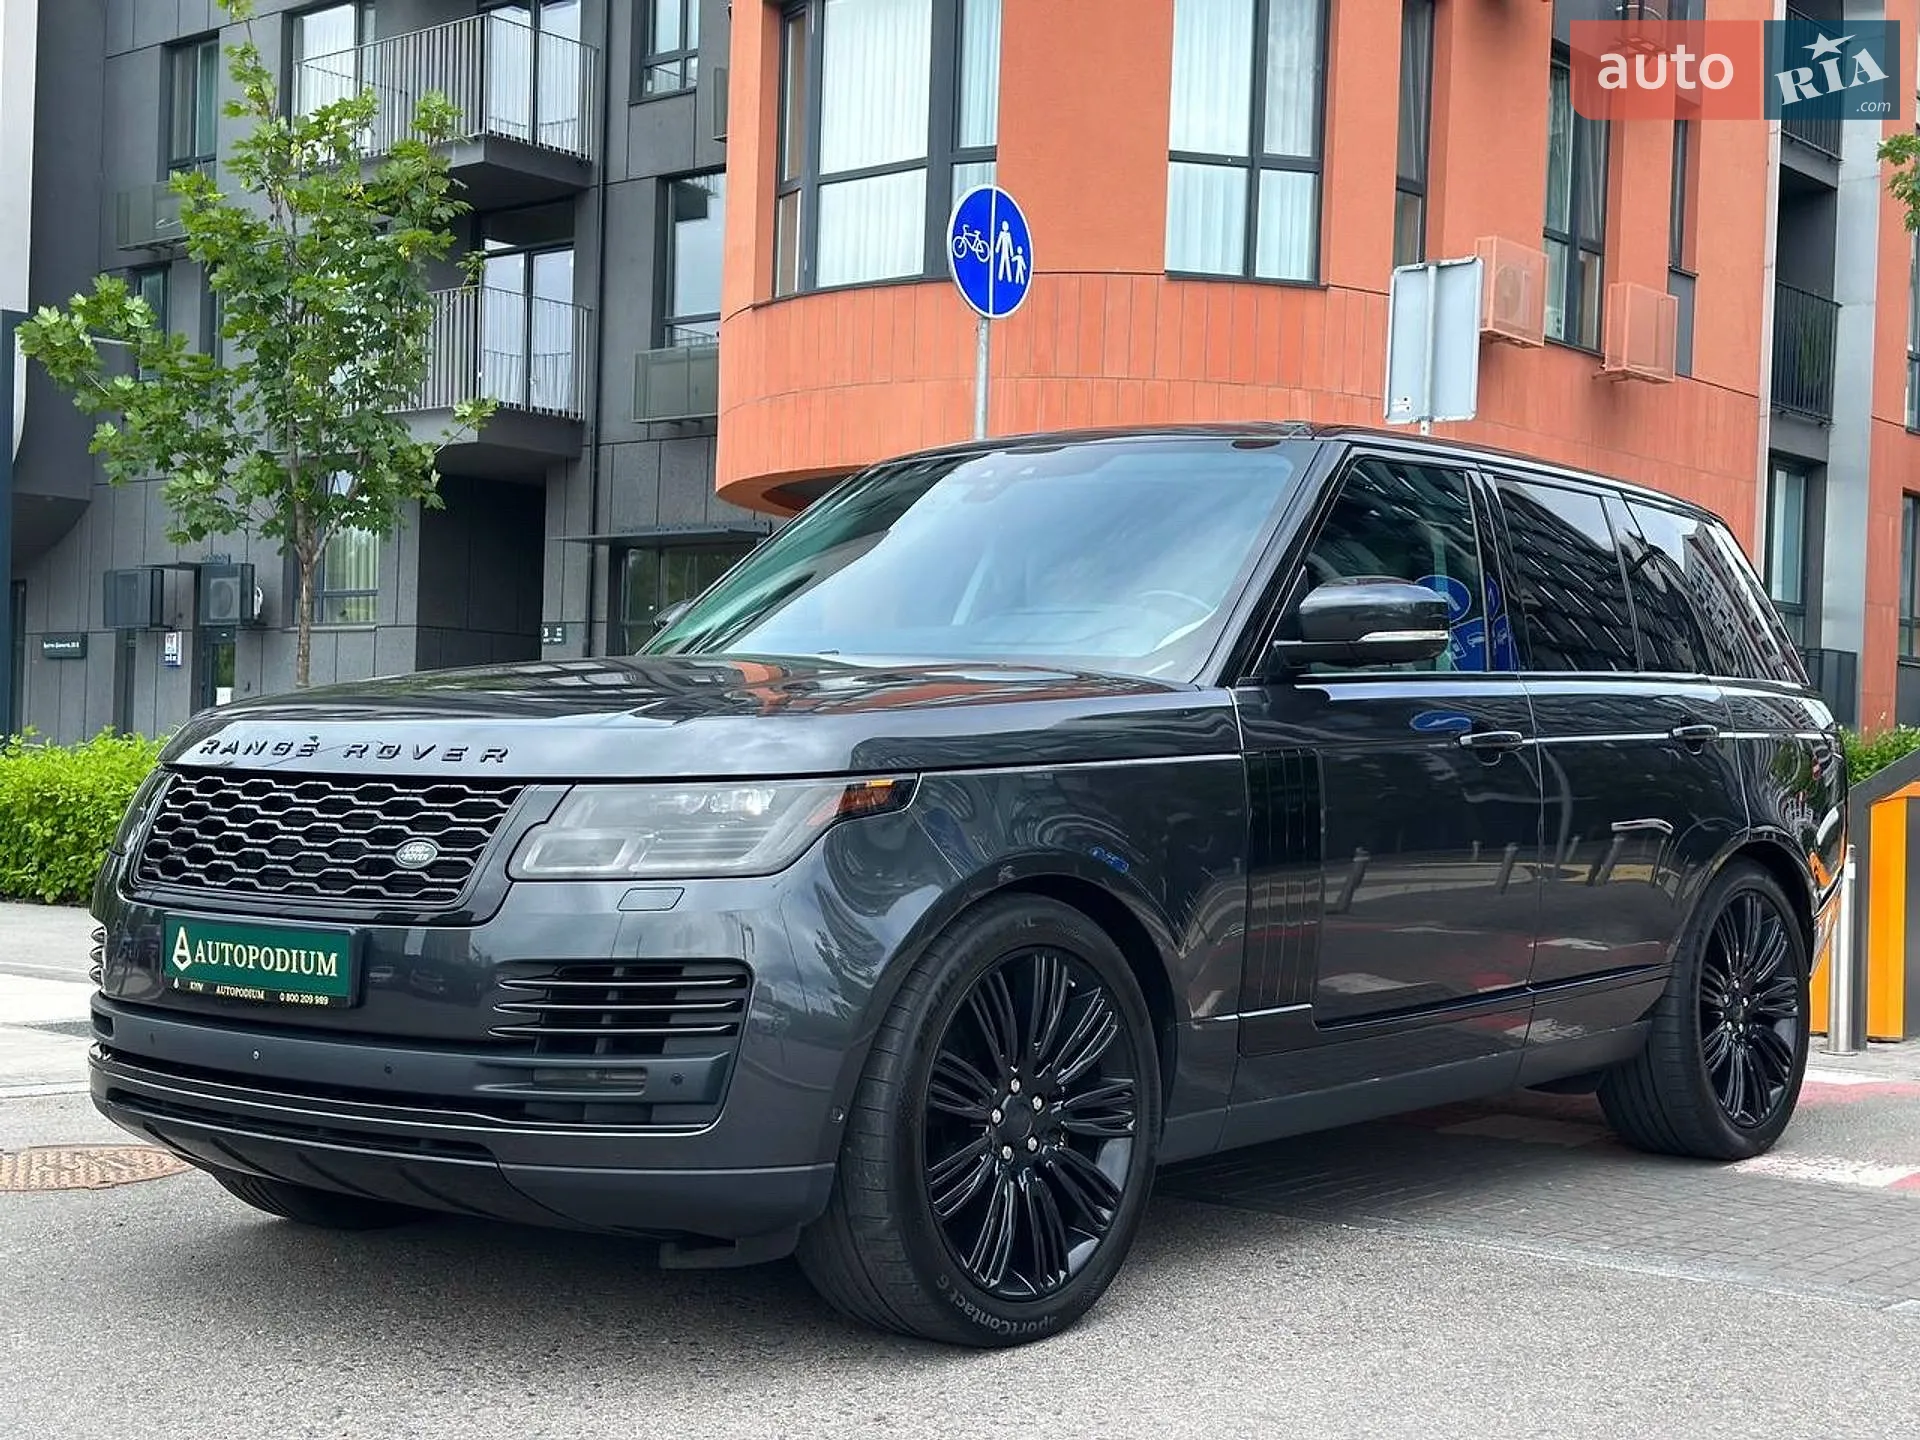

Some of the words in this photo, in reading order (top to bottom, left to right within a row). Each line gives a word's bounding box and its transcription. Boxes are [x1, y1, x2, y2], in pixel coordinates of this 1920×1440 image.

[200, 739, 319, 757] RANGE
[343, 743, 509, 763] ROVER
[195, 939, 338, 977] AUTOPODIUM
[216, 985, 265, 999] AUTOPODIUM
[279, 992, 285, 1002] 0
